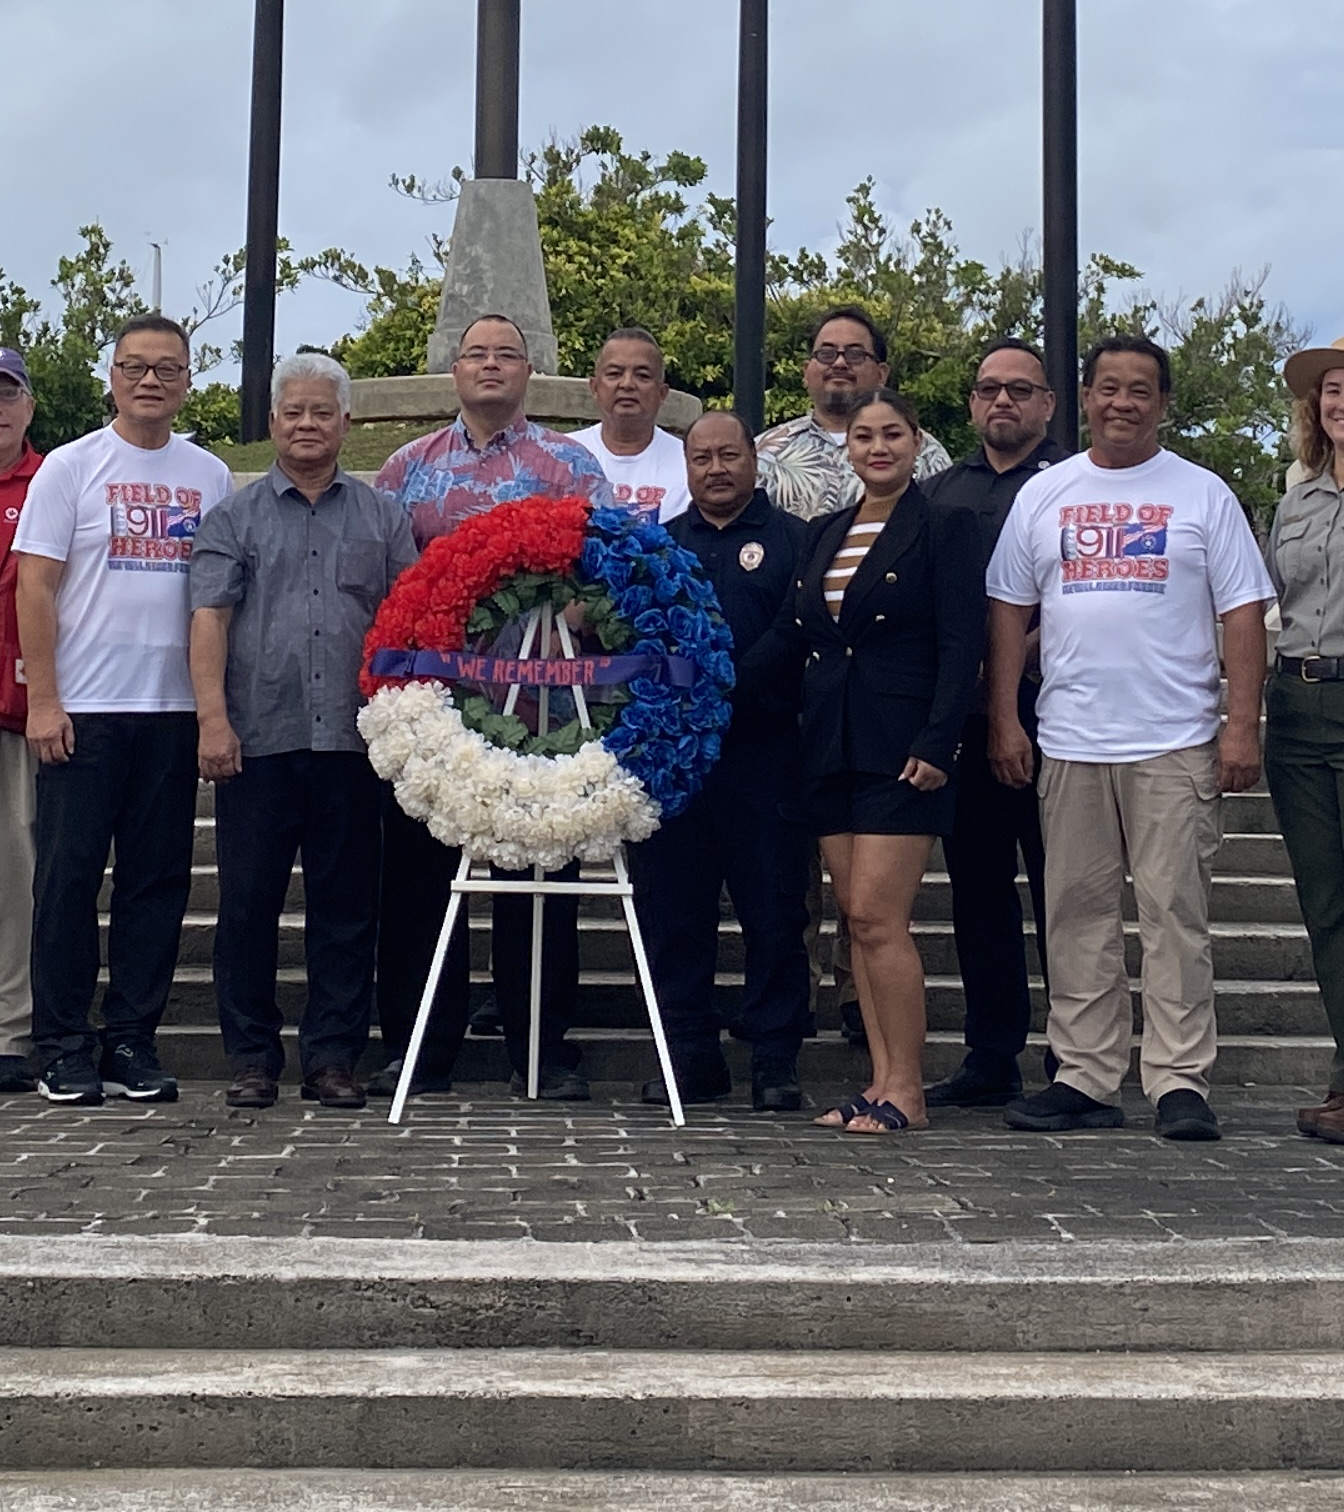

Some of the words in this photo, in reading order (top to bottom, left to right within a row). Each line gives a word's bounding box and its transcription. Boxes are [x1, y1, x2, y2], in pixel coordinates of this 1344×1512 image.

[106, 483, 172, 505] FIELD
[175, 486, 202, 510] OF
[1060, 503, 1133, 527] FIELD
[1137, 504, 1174, 525] OF
[109, 537, 193, 560] HEROE
[1061, 559, 1169, 582] HEROES
